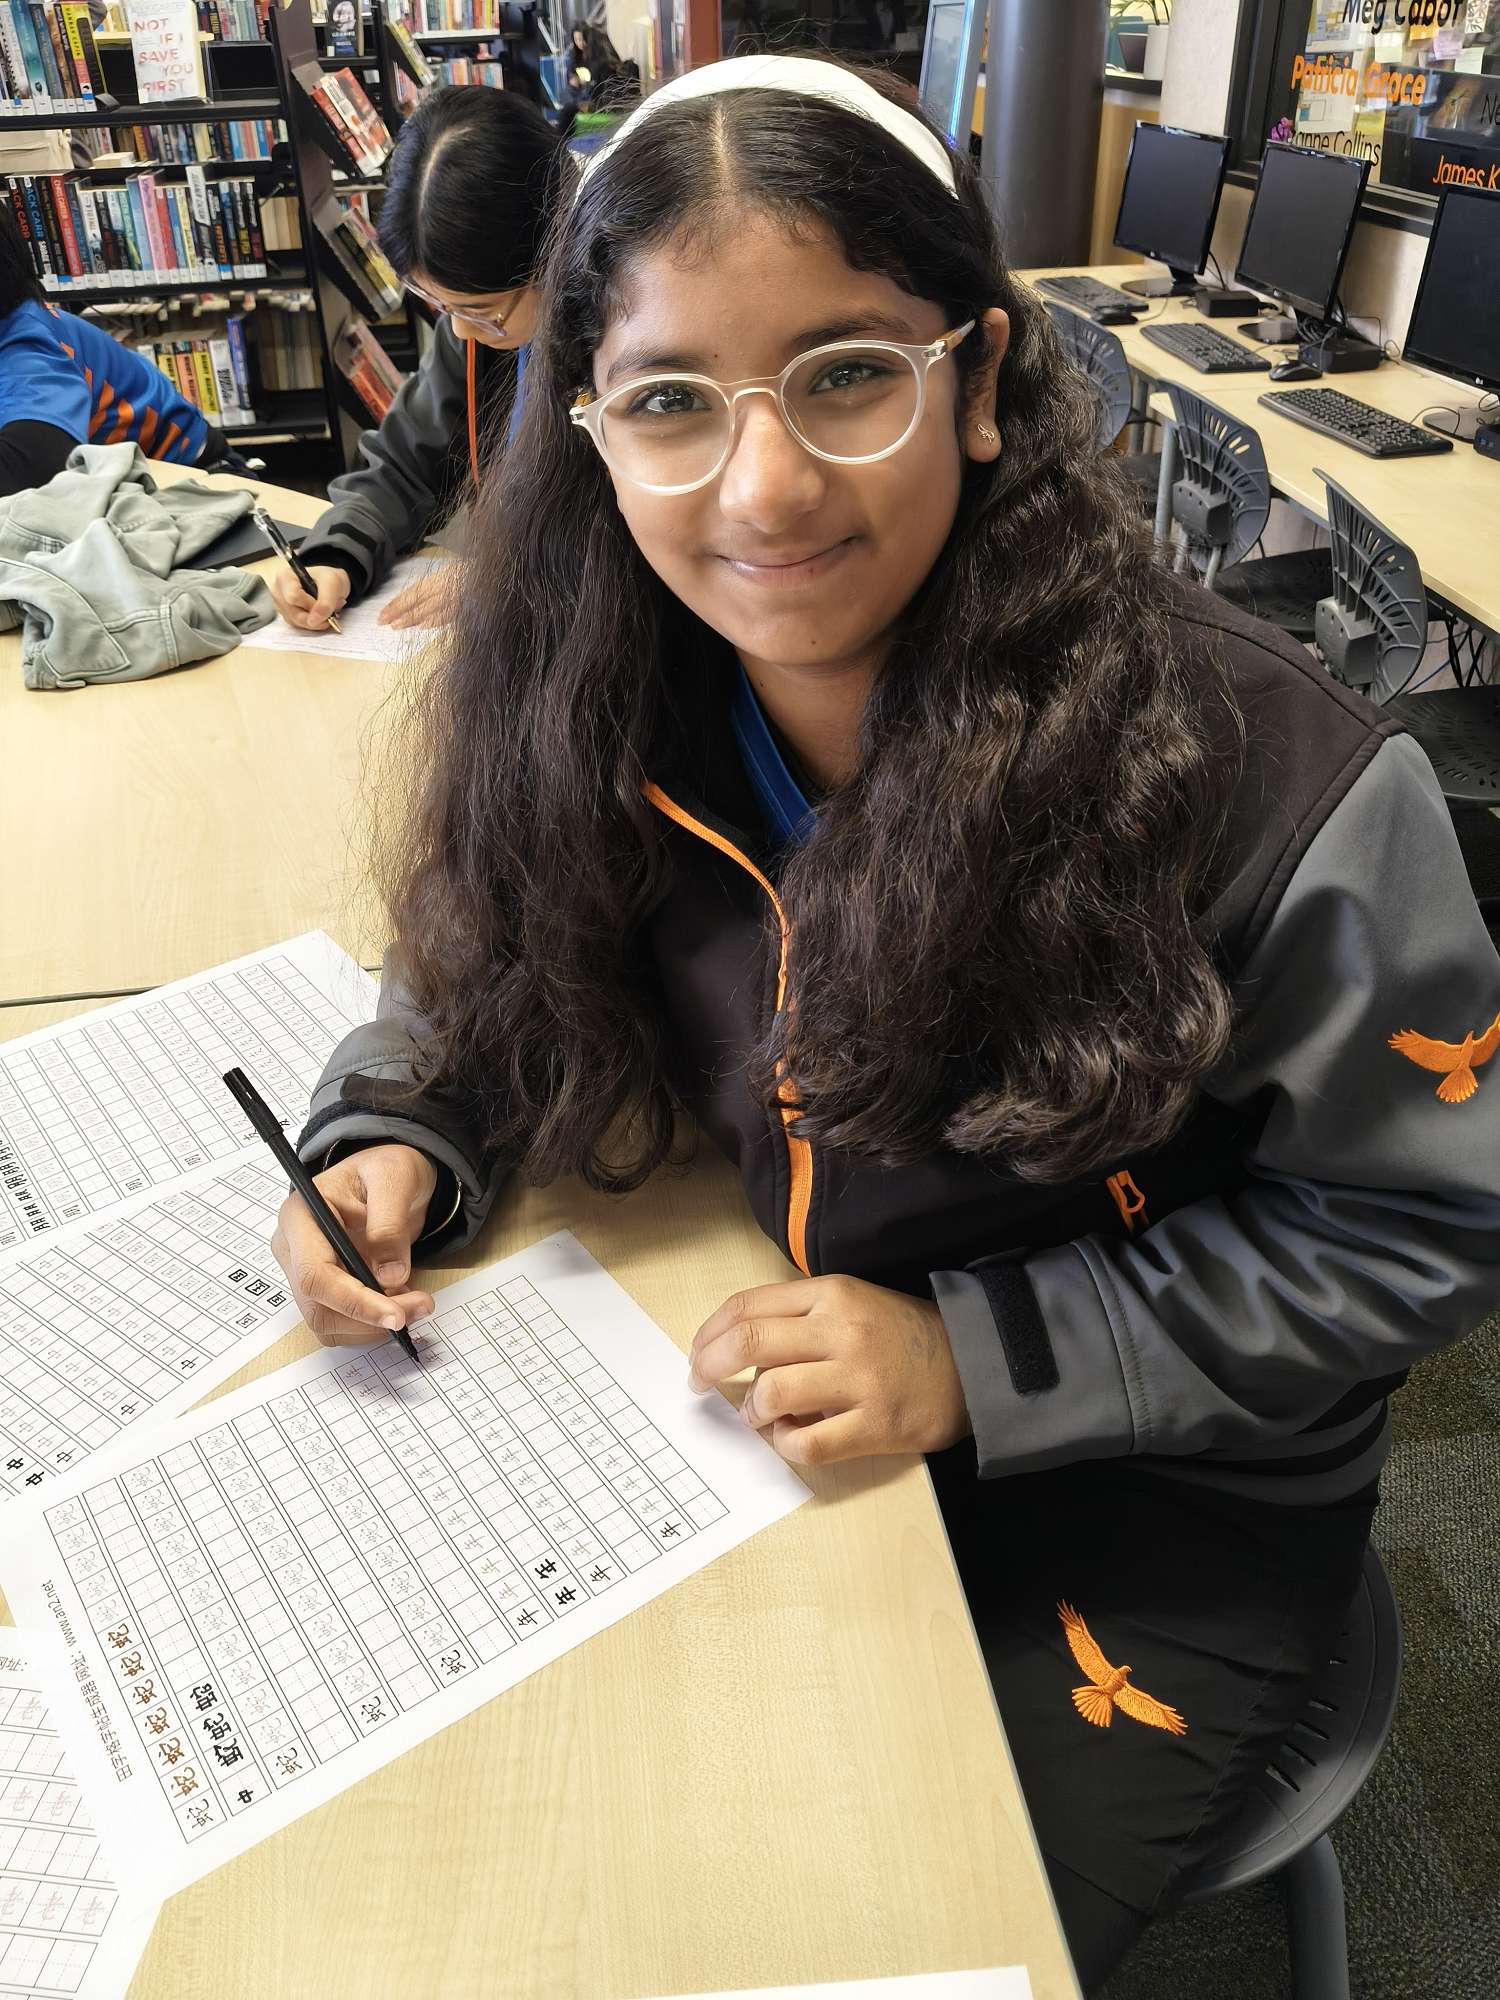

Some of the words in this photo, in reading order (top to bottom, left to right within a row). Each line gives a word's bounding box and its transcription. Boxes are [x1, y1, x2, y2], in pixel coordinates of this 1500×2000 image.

[134, 18, 168, 32] NOT
[1342, 0, 1386, 34] Meg
[1394, 0, 1462, 27] Cabot
[160, 33, 173, 44] IF
[138, 49, 178, 64] SAVE
[162, 63, 193, 76] YOU
[143, 79, 184, 93] FIRST
[1290, 55, 1357, 96] Patricia
[1362, 61, 1427, 106] Grace
[1334, 131, 1381, 166] Collins
[1433, 155, 1485, 187] James
[227, 1268, 248, 1282] 国
[244, 1278, 270, 1296] 国
[266, 1290, 286, 1307] 国
[235, 1312, 257, 1328] 国
[181, 1356, 198, 1369] 中
[120, 1401, 138, 1415] 中
[6, 1457, 23, 1470] 中
[56, 1448, 76, 1463] 中
[25, 1471, 44, 1486] 中
[660, 1521, 680, 1537] 年
[534, 1558, 556, 1578] 年
[589, 1564, 611, 1581] 年
[554, 1586, 576, 1605] 年
[41, 1580, 77, 1648] www.an2.net
[516, 1608, 538, 1625] 年
[108, 1623, 132, 1648] 蛇
[120, 1651, 144, 1676] 蛇
[440, 1649, 465, 1675] 蛇
[132, 1679, 156, 1704] 蛇
[189, 1683, 217, 1710] 蛇
[361, 1695, 385, 1723] 蛇
[144, 1706, 169, 1734] 蛇
[204, 1712, 231, 1740] 蛇
[81, 1681, 132, 1782] 田字格字帖生成器
[158, 1737, 184, 1765] 蛇
[275, 1747, 302, 1774] 蛇
[170, 1766, 198, 1797] 蛇
[186, 1798, 213, 1828] 蛇
